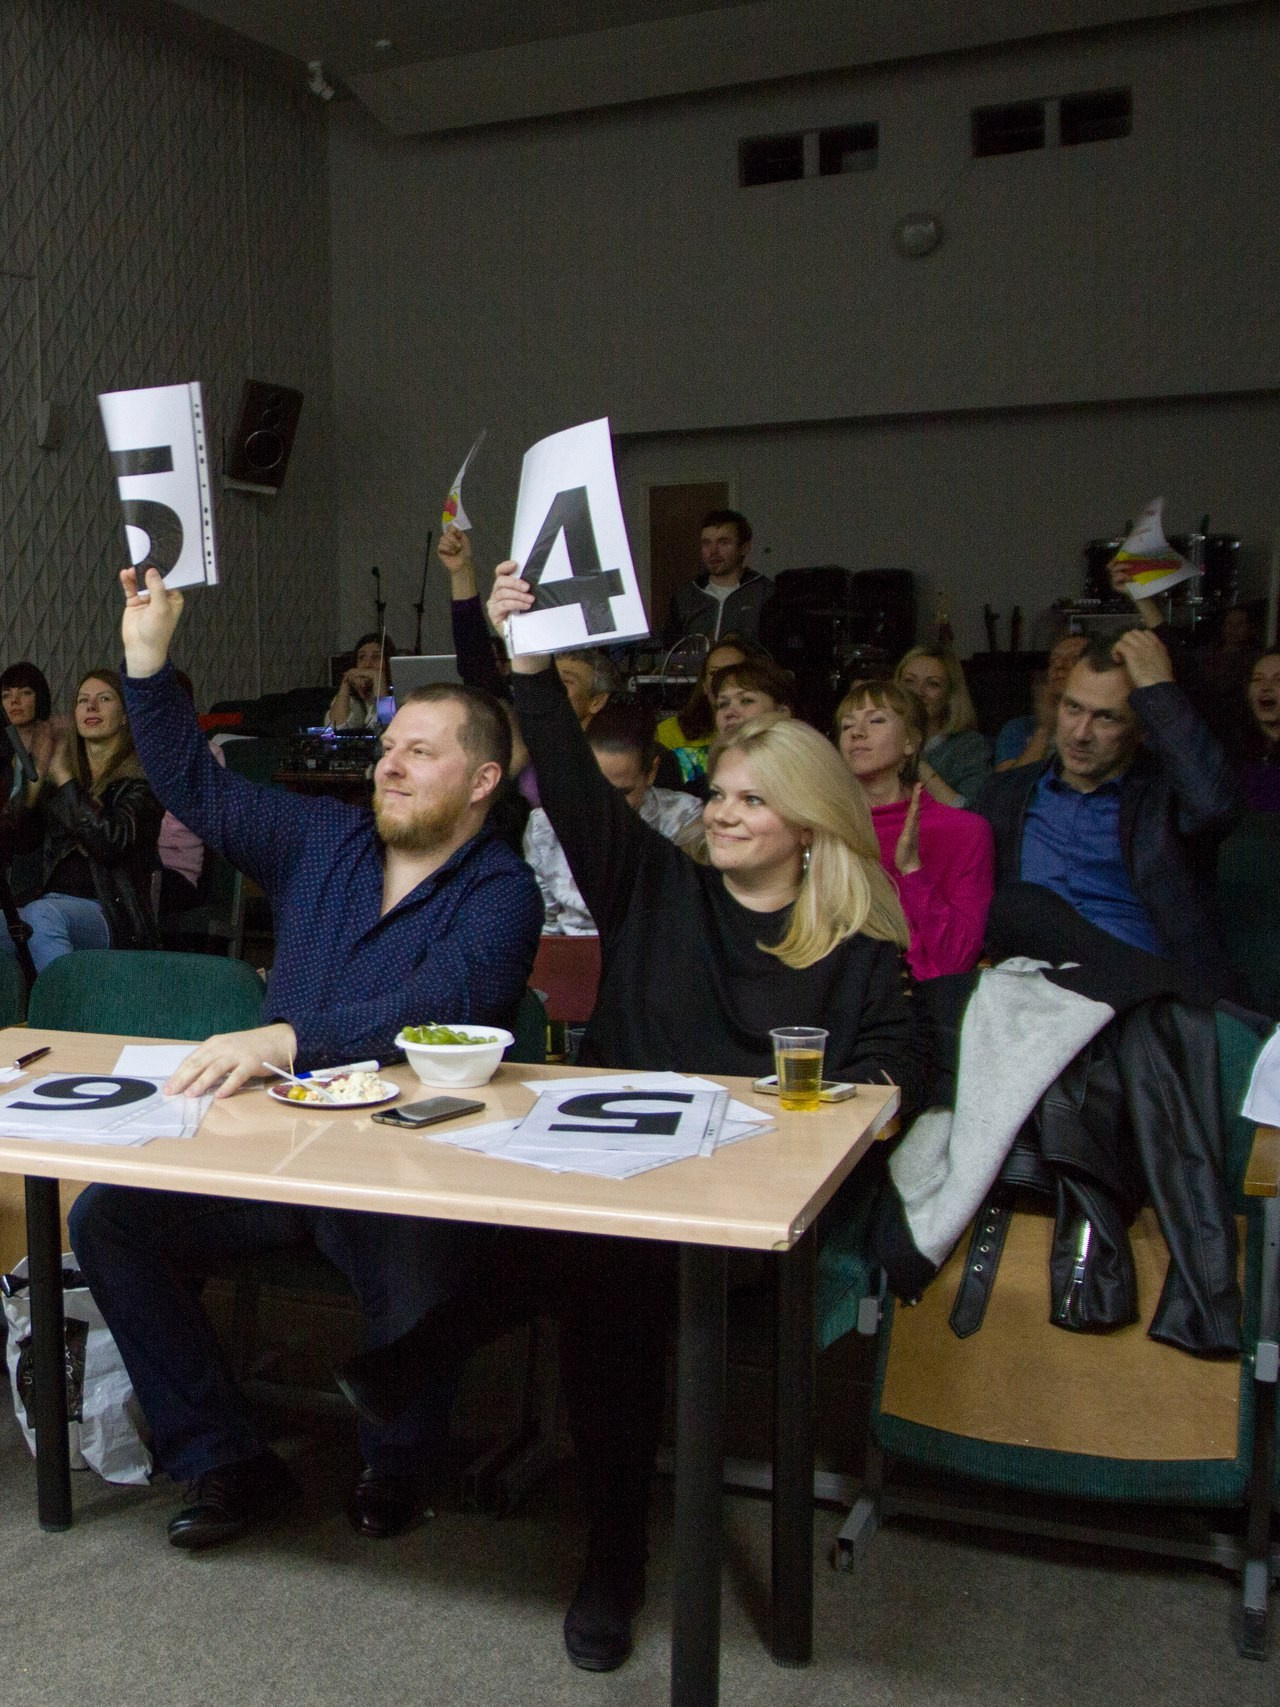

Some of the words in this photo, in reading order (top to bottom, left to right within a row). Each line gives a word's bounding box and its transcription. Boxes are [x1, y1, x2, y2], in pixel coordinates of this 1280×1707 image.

[109, 444, 184, 593] 5
[519, 485, 626, 636] 4
[547, 1091, 695, 1136] 5
